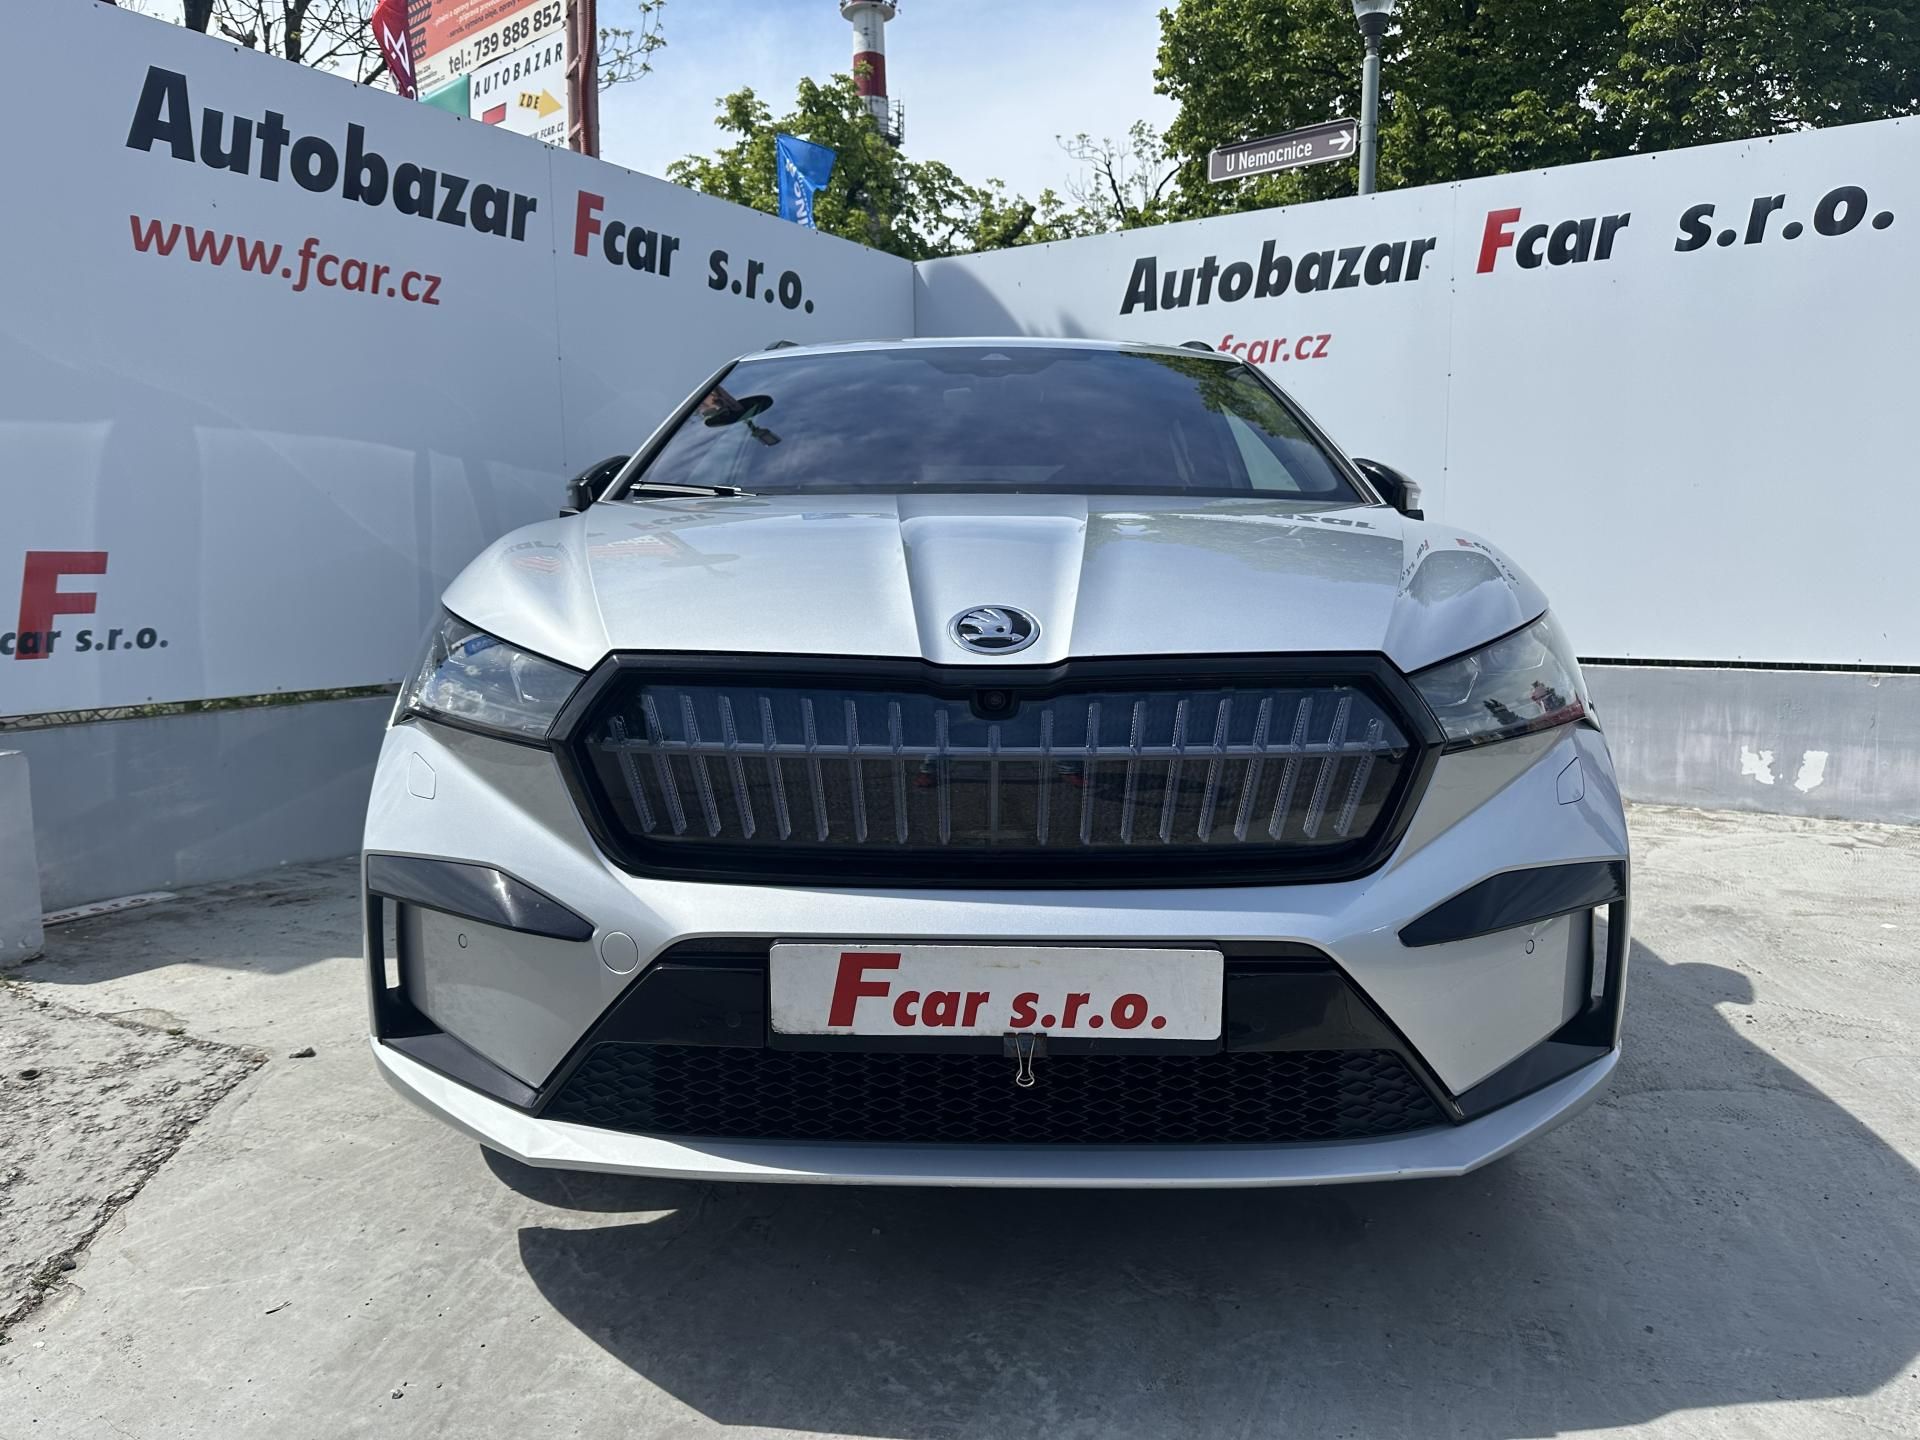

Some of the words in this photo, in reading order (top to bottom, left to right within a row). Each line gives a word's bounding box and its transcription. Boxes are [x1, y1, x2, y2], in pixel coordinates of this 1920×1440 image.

[449, 46, 471, 74] tel.:
[474, 32, 499, 61] 739
[503, 17, 529, 47] 888
[533, 1, 561, 32] 852
[473, 41, 563, 99] AUTOBAZAR
[520, 93, 540, 109] ZDE
[126, 65, 538, 241] Autobazar
[574, 190, 680, 278] Fcar
[708, 249, 815, 314] s.r.o.
[1226, 154, 1235, 172] U
[1238, 140, 1313, 170] Nemocnice
[129, 214, 443, 306] www.fcar.cz
[1119, 238, 1437, 315] Autobazar
[1476, 207, 1631, 274] Fcar
[1674, 185, 1896, 252] s.r.o.
[75, 627, 169, 652] s.r.o.
[828, 952, 990, 1028] Fcar
[1009, 992, 1168, 1030] s.r.o.
